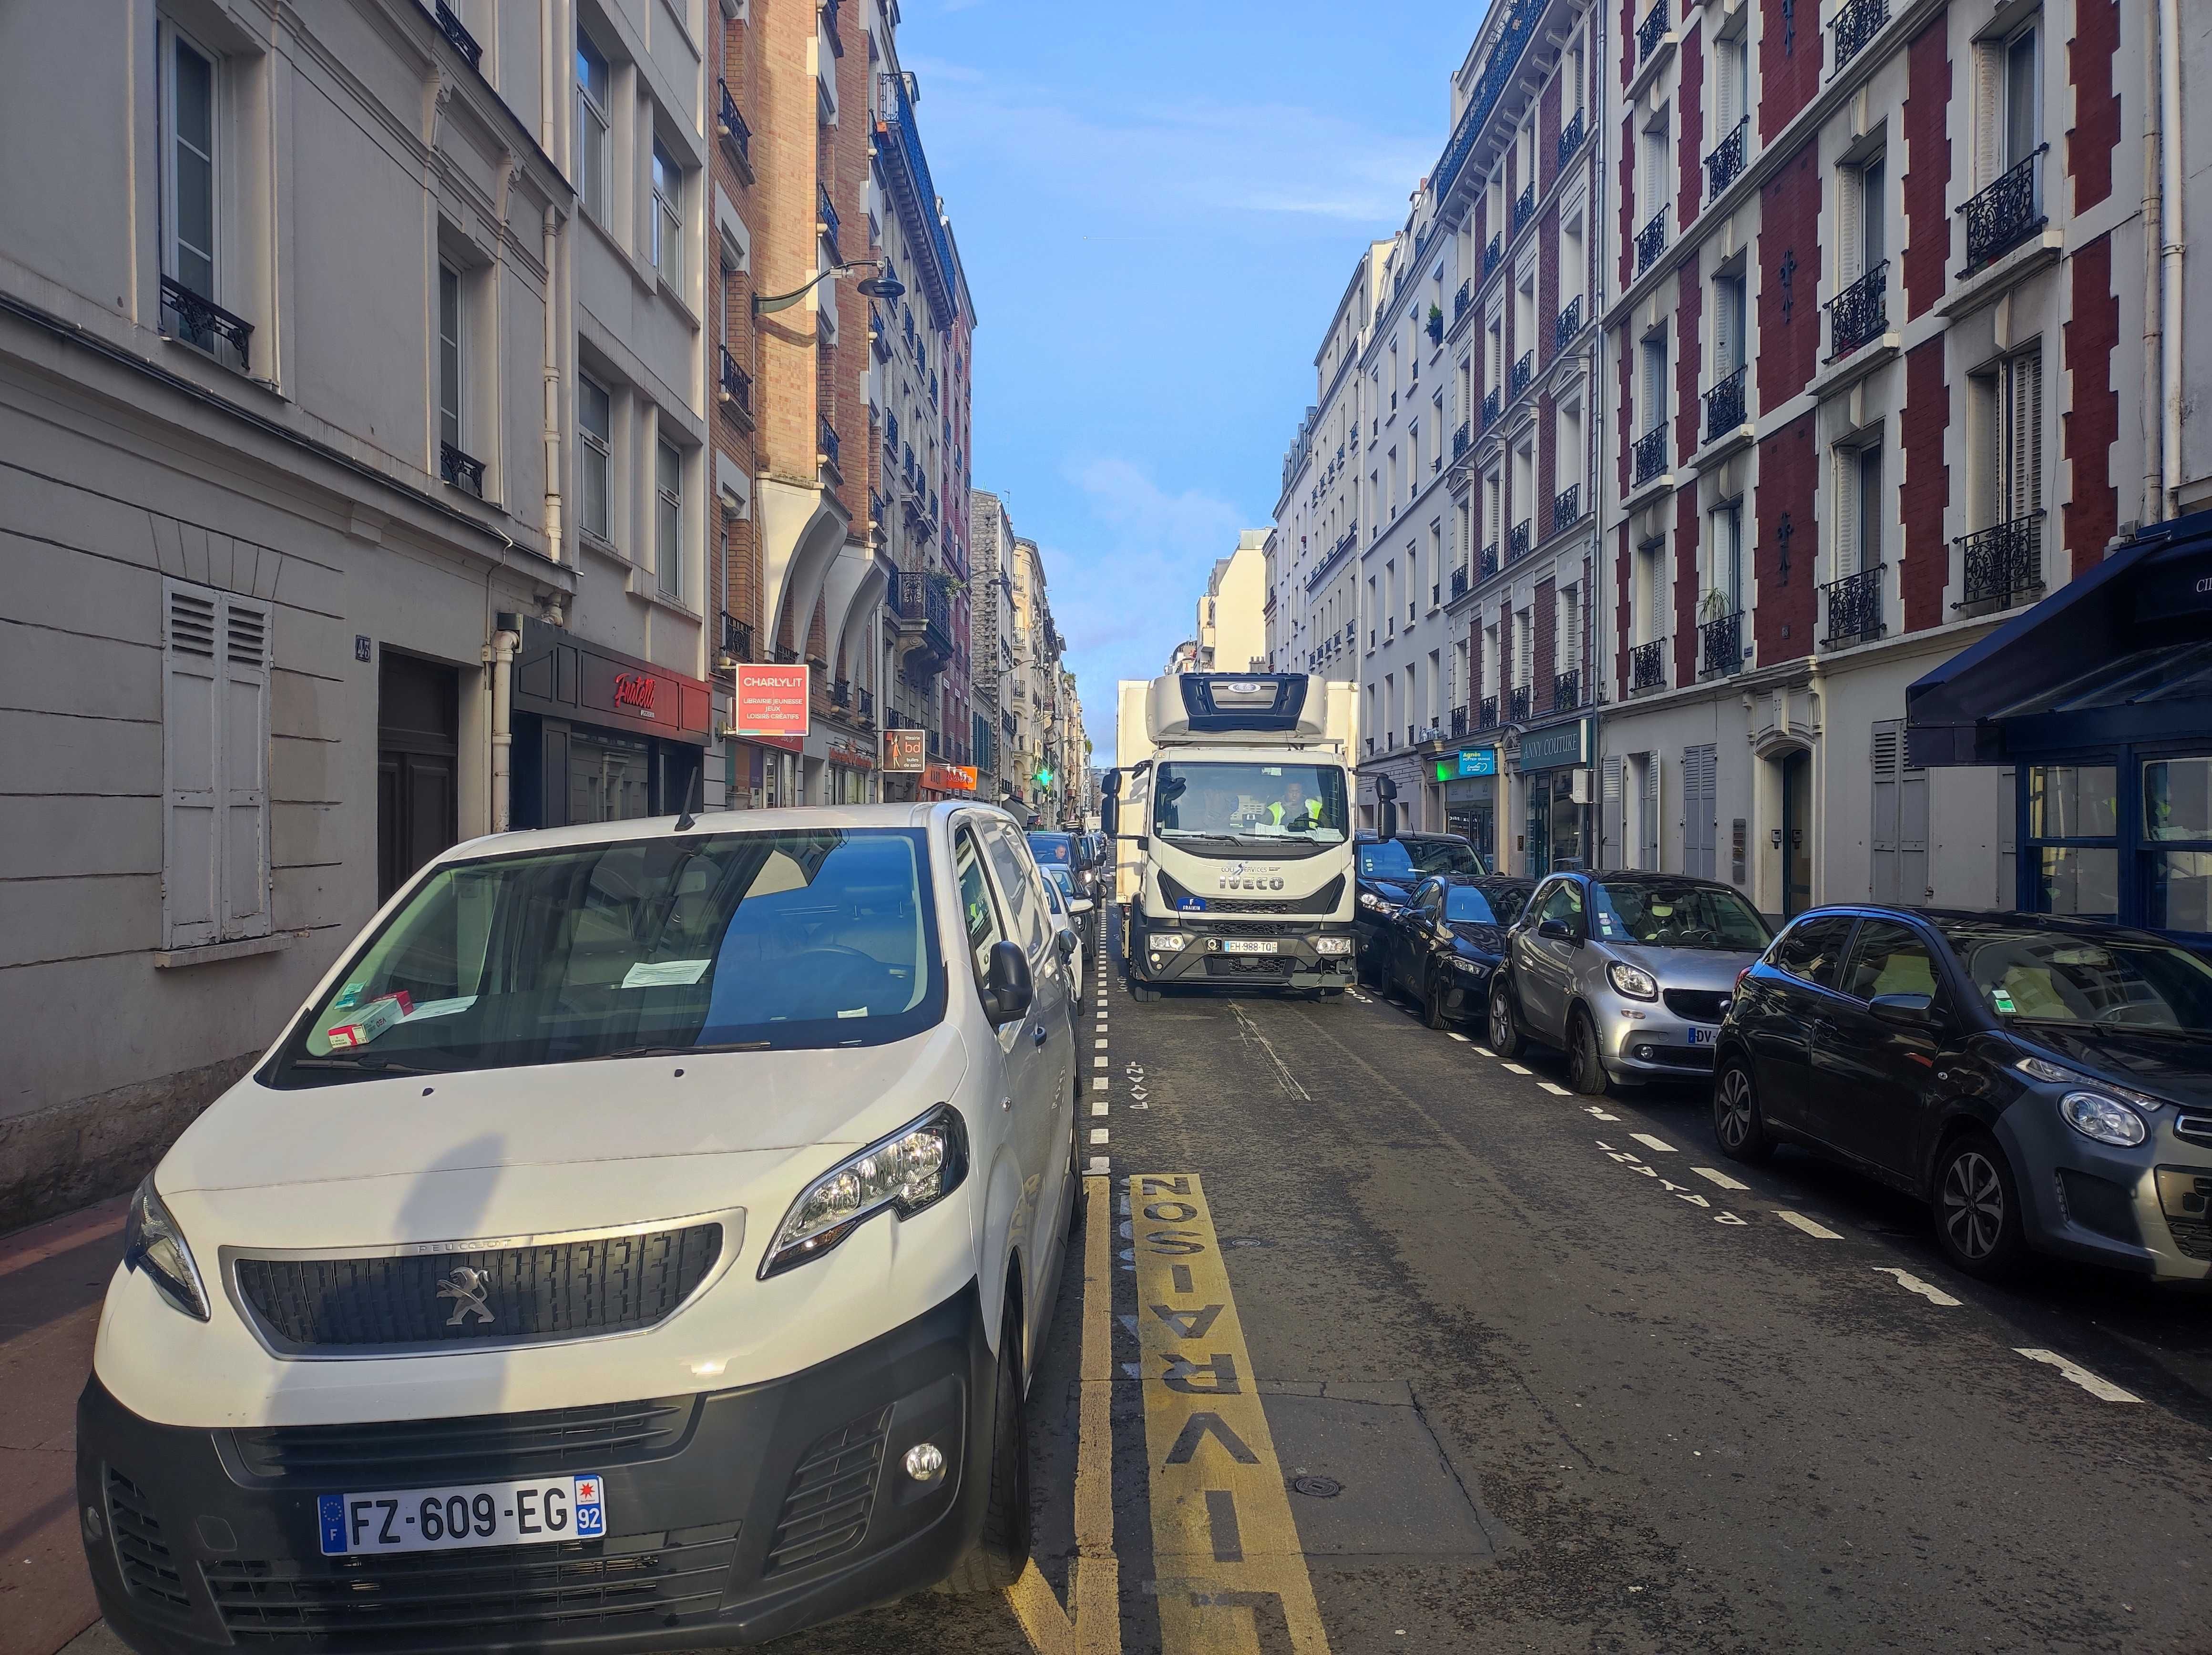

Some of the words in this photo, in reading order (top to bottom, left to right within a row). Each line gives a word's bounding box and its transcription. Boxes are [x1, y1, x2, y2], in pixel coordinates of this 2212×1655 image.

[358, 640, 369, 658] 43
[614, 673, 655, 709] Fratelli
[744, 677, 803, 686] CHARLYLIT
[905, 741, 921, 753] bd
[1523, 741, 1541, 759] ANNY
[1544, 734, 1577, 756] COUTURE
[1219, 876, 1284, 890] IVECO
[1126, 1061, 1149, 1109] PAYANT
[1595, 1141, 1749, 1225] PAYANT
[1141, 1176, 1298, 1655] LIVRAISON
[330, 1529, 338, 1542] F
[350, 1487, 568, 1546] FZ-609-EG
[578, 1507, 602, 1529] 92
